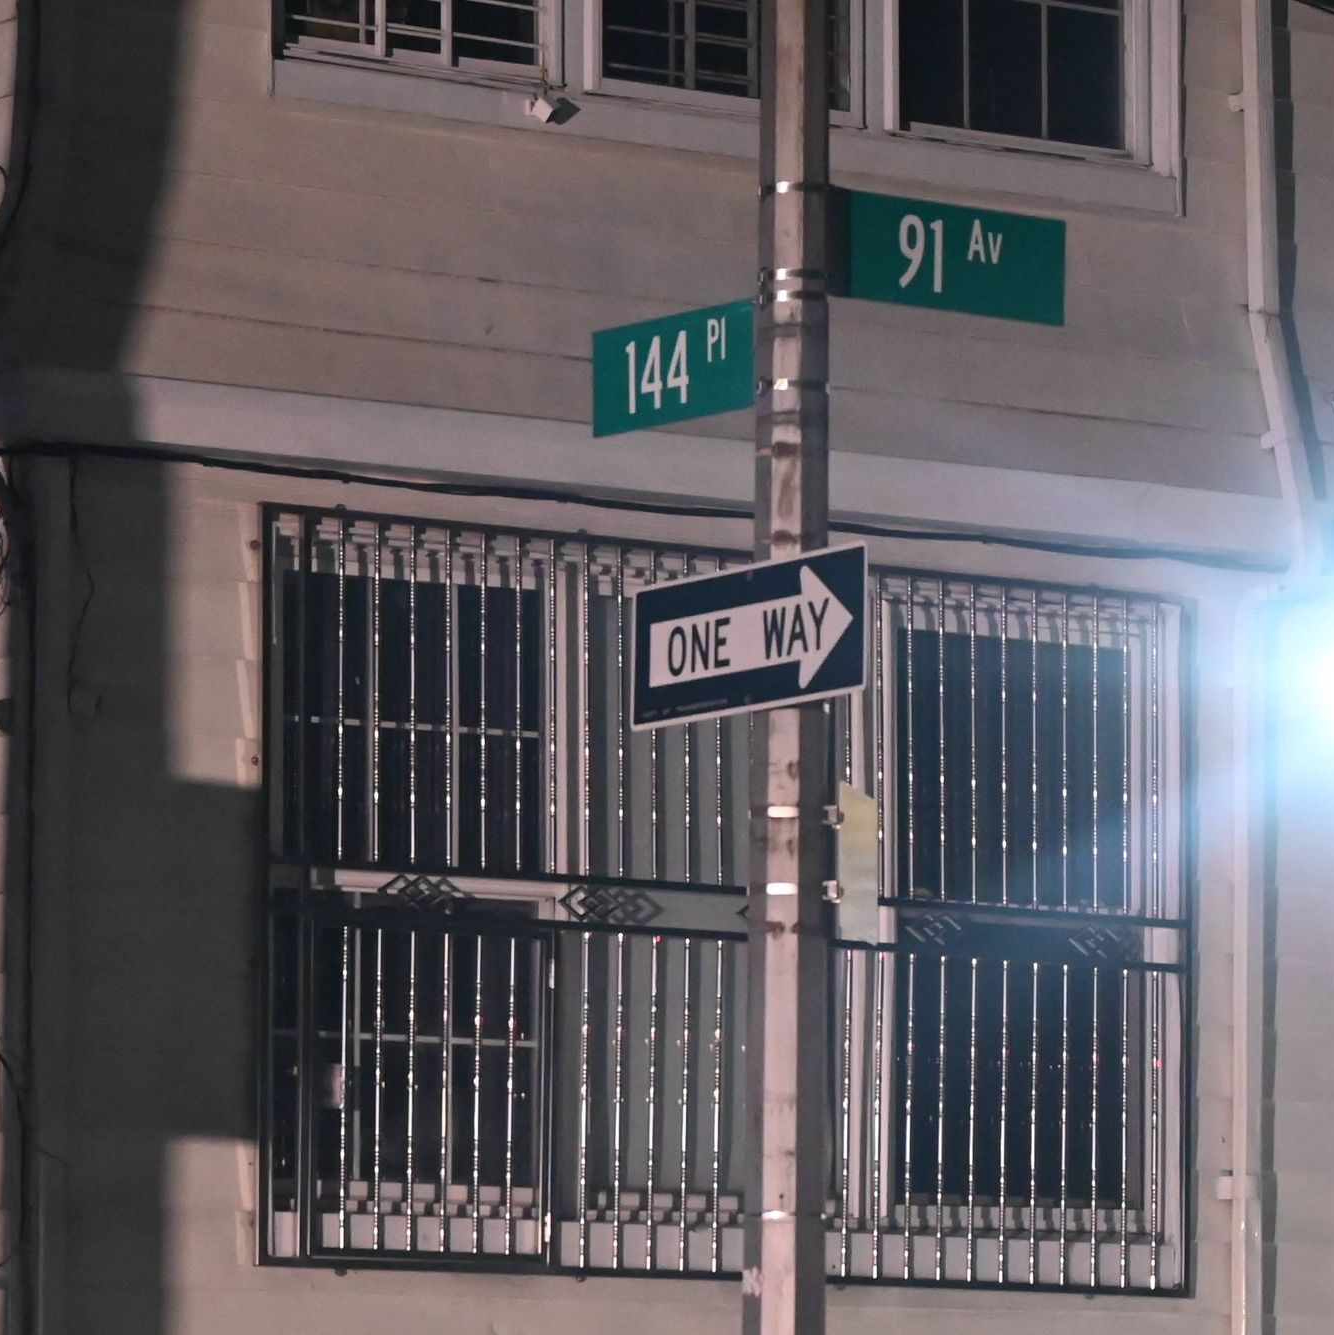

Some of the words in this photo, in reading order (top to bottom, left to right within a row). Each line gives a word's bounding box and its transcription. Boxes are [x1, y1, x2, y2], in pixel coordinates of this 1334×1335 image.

[899, 214, 944, 293] 91
[968, 218, 1003, 265] Av
[625, 329, 690, 415] 144
[707, 316, 726, 363] Pl
[667, 616, 731, 677] ONE
[762, 597, 831, 660] WAY
